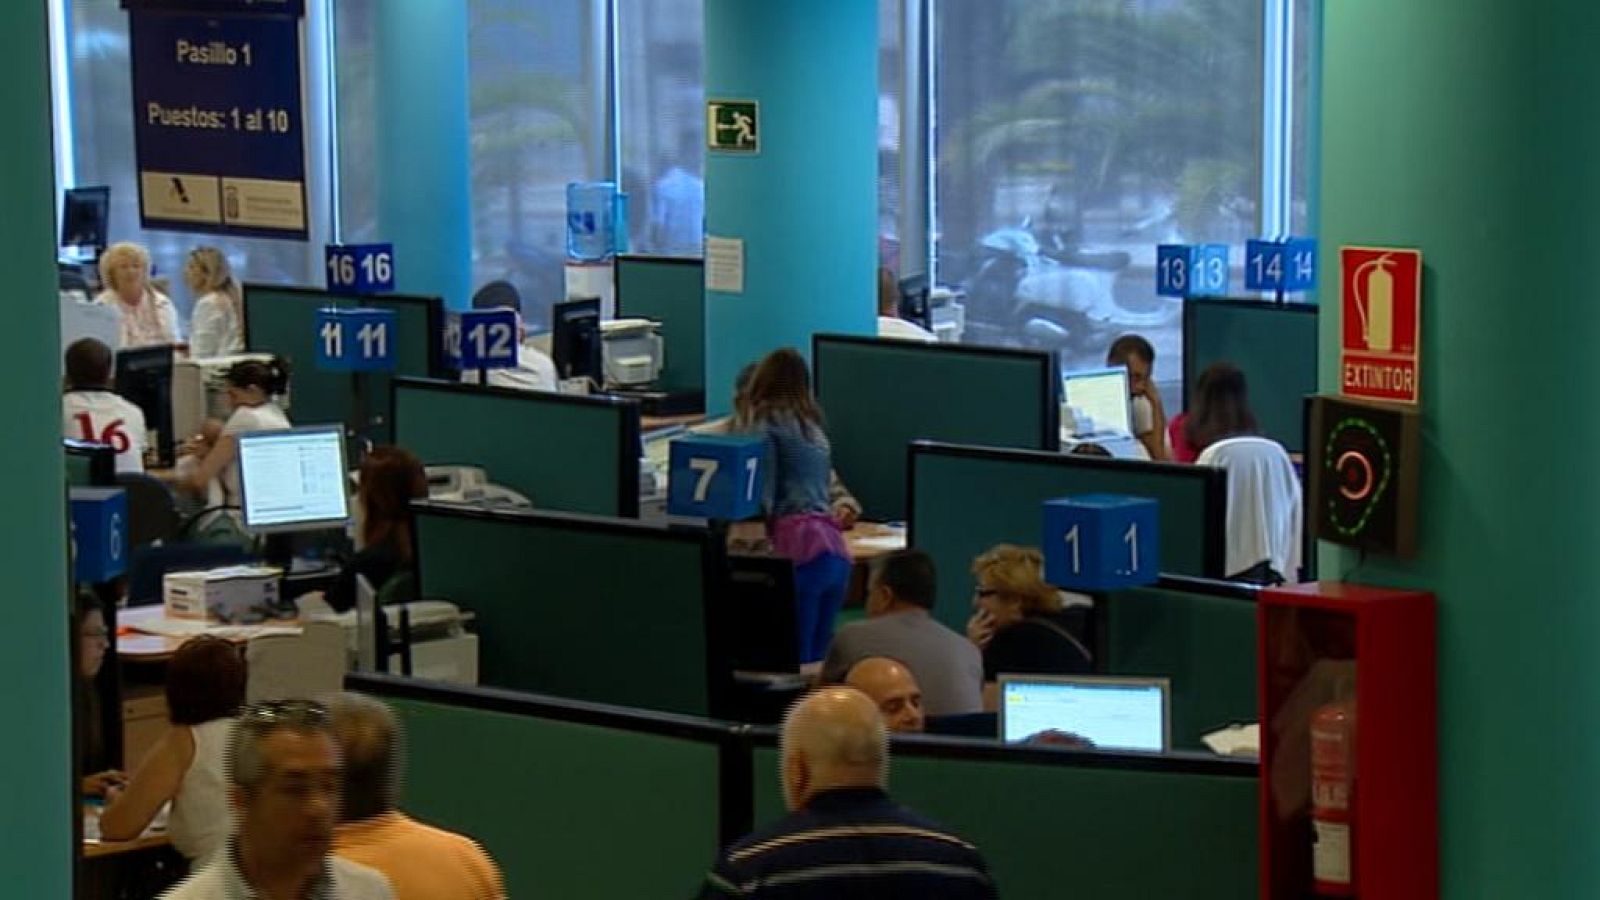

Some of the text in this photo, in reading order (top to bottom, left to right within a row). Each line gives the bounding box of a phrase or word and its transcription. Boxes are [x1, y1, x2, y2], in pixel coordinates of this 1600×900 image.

[176, 39, 252, 66] Pasillo 1
[147, 102, 289, 133] Puestos: 1 al 10
[327, 252, 392, 284] 16 16
[1160, 255, 1225, 291] 13 13
[1252, 251, 1313, 285] 14 14
[320, 321, 388, 359] 11 11
[467, 321, 514, 360] 12
[1344, 363, 1412, 392] EXTINTOR
[73, 411, 131, 454] 16
[689, 455, 758, 503] 7 1
[110, 511, 123, 562] 6
[1062, 519, 1139, 575] 1 1
